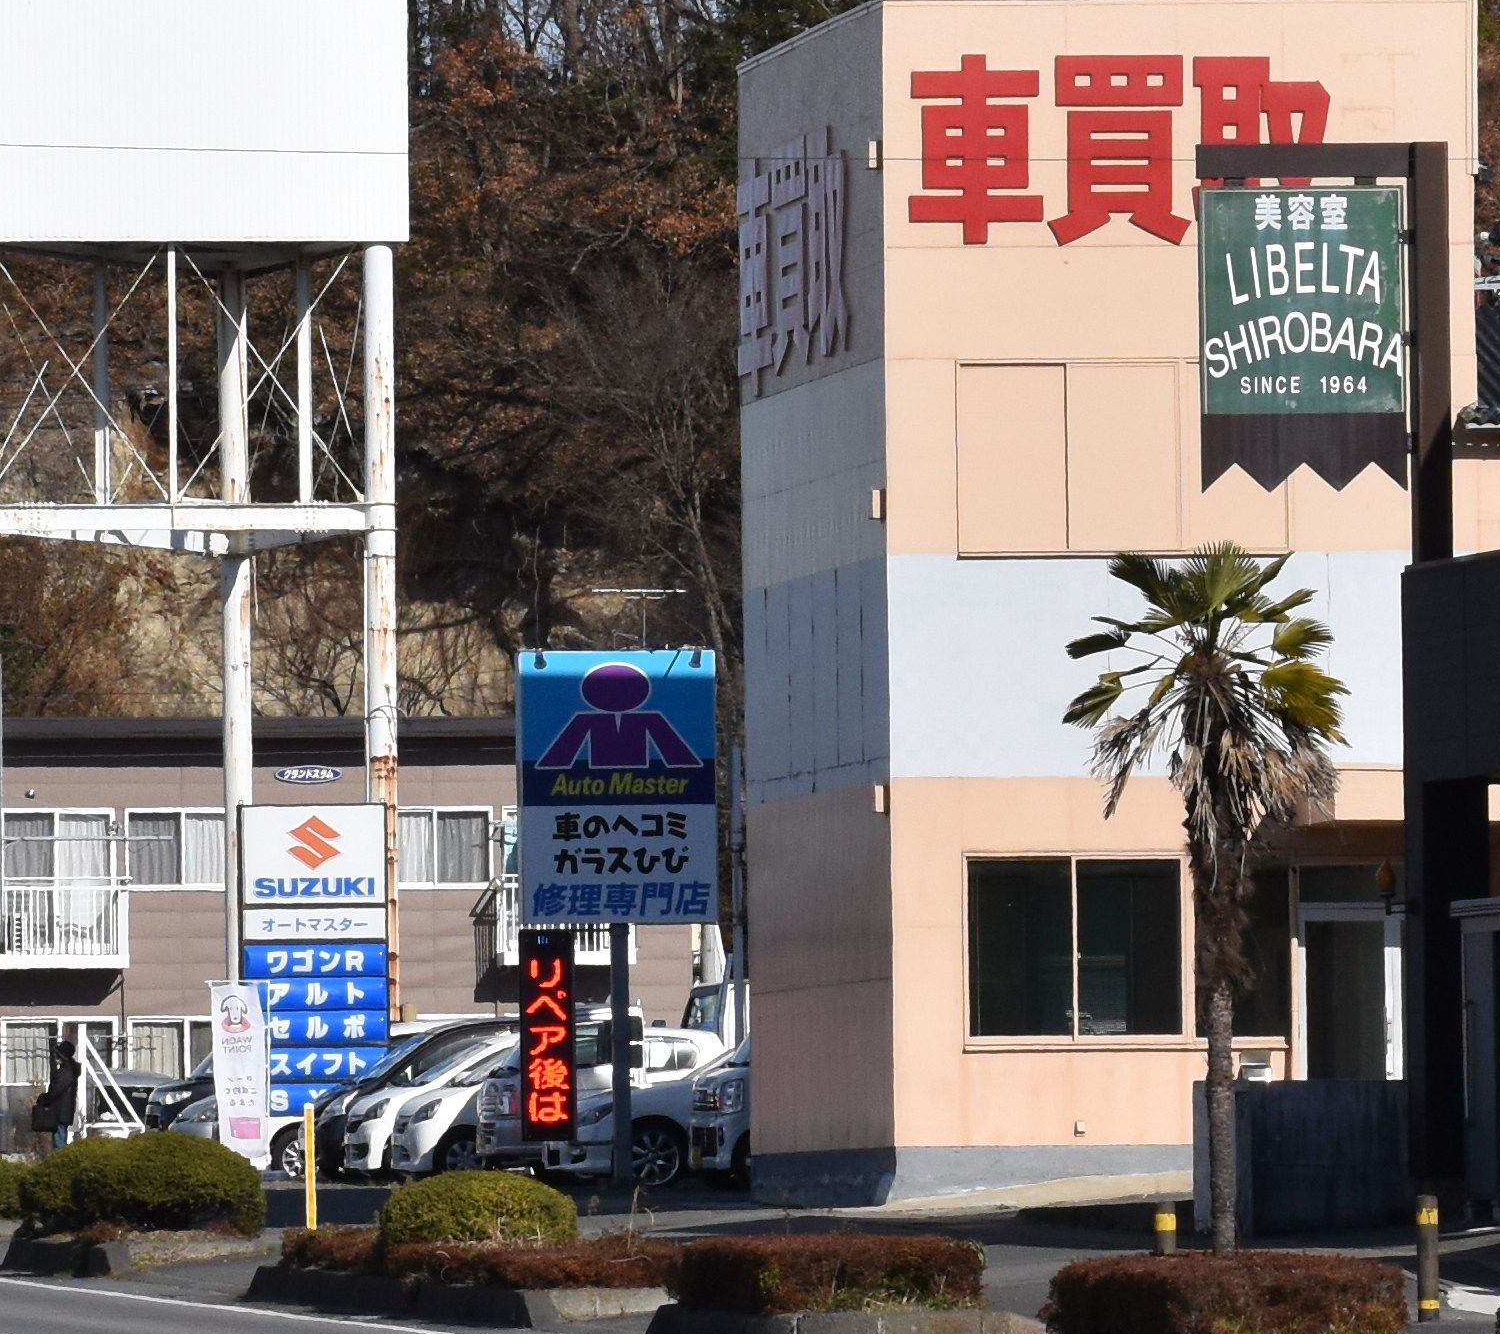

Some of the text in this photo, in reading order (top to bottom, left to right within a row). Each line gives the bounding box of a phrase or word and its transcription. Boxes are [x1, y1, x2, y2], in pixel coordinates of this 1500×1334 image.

[1254, 194, 1348, 230] 美容室
[739, 125, 848, 397] 車買取
[1226, 241, 1381, 305] LIBELTA
[1205, 311, 1402, 378] SHIROBARA
[1240, 375, 1367, 394] SINCE 1964
[551, 773, 689, 795] Auto Master
[553, 811, 688, 841] 車のヘコミ
[554, 846, 689, 874] ガラスひび
[255, 876, 375, 898] SUZUKI
[533, 881, 711, 916] 修理専門店
[262, 917, 368, 932] オートマスター
[267, 949, 365, 973] ワゴンR
[269, 982, 365, 1006] アルト
[526, 958, 570, 1122] リペア後は
[270, 1051, 367, 1076] スイフト
